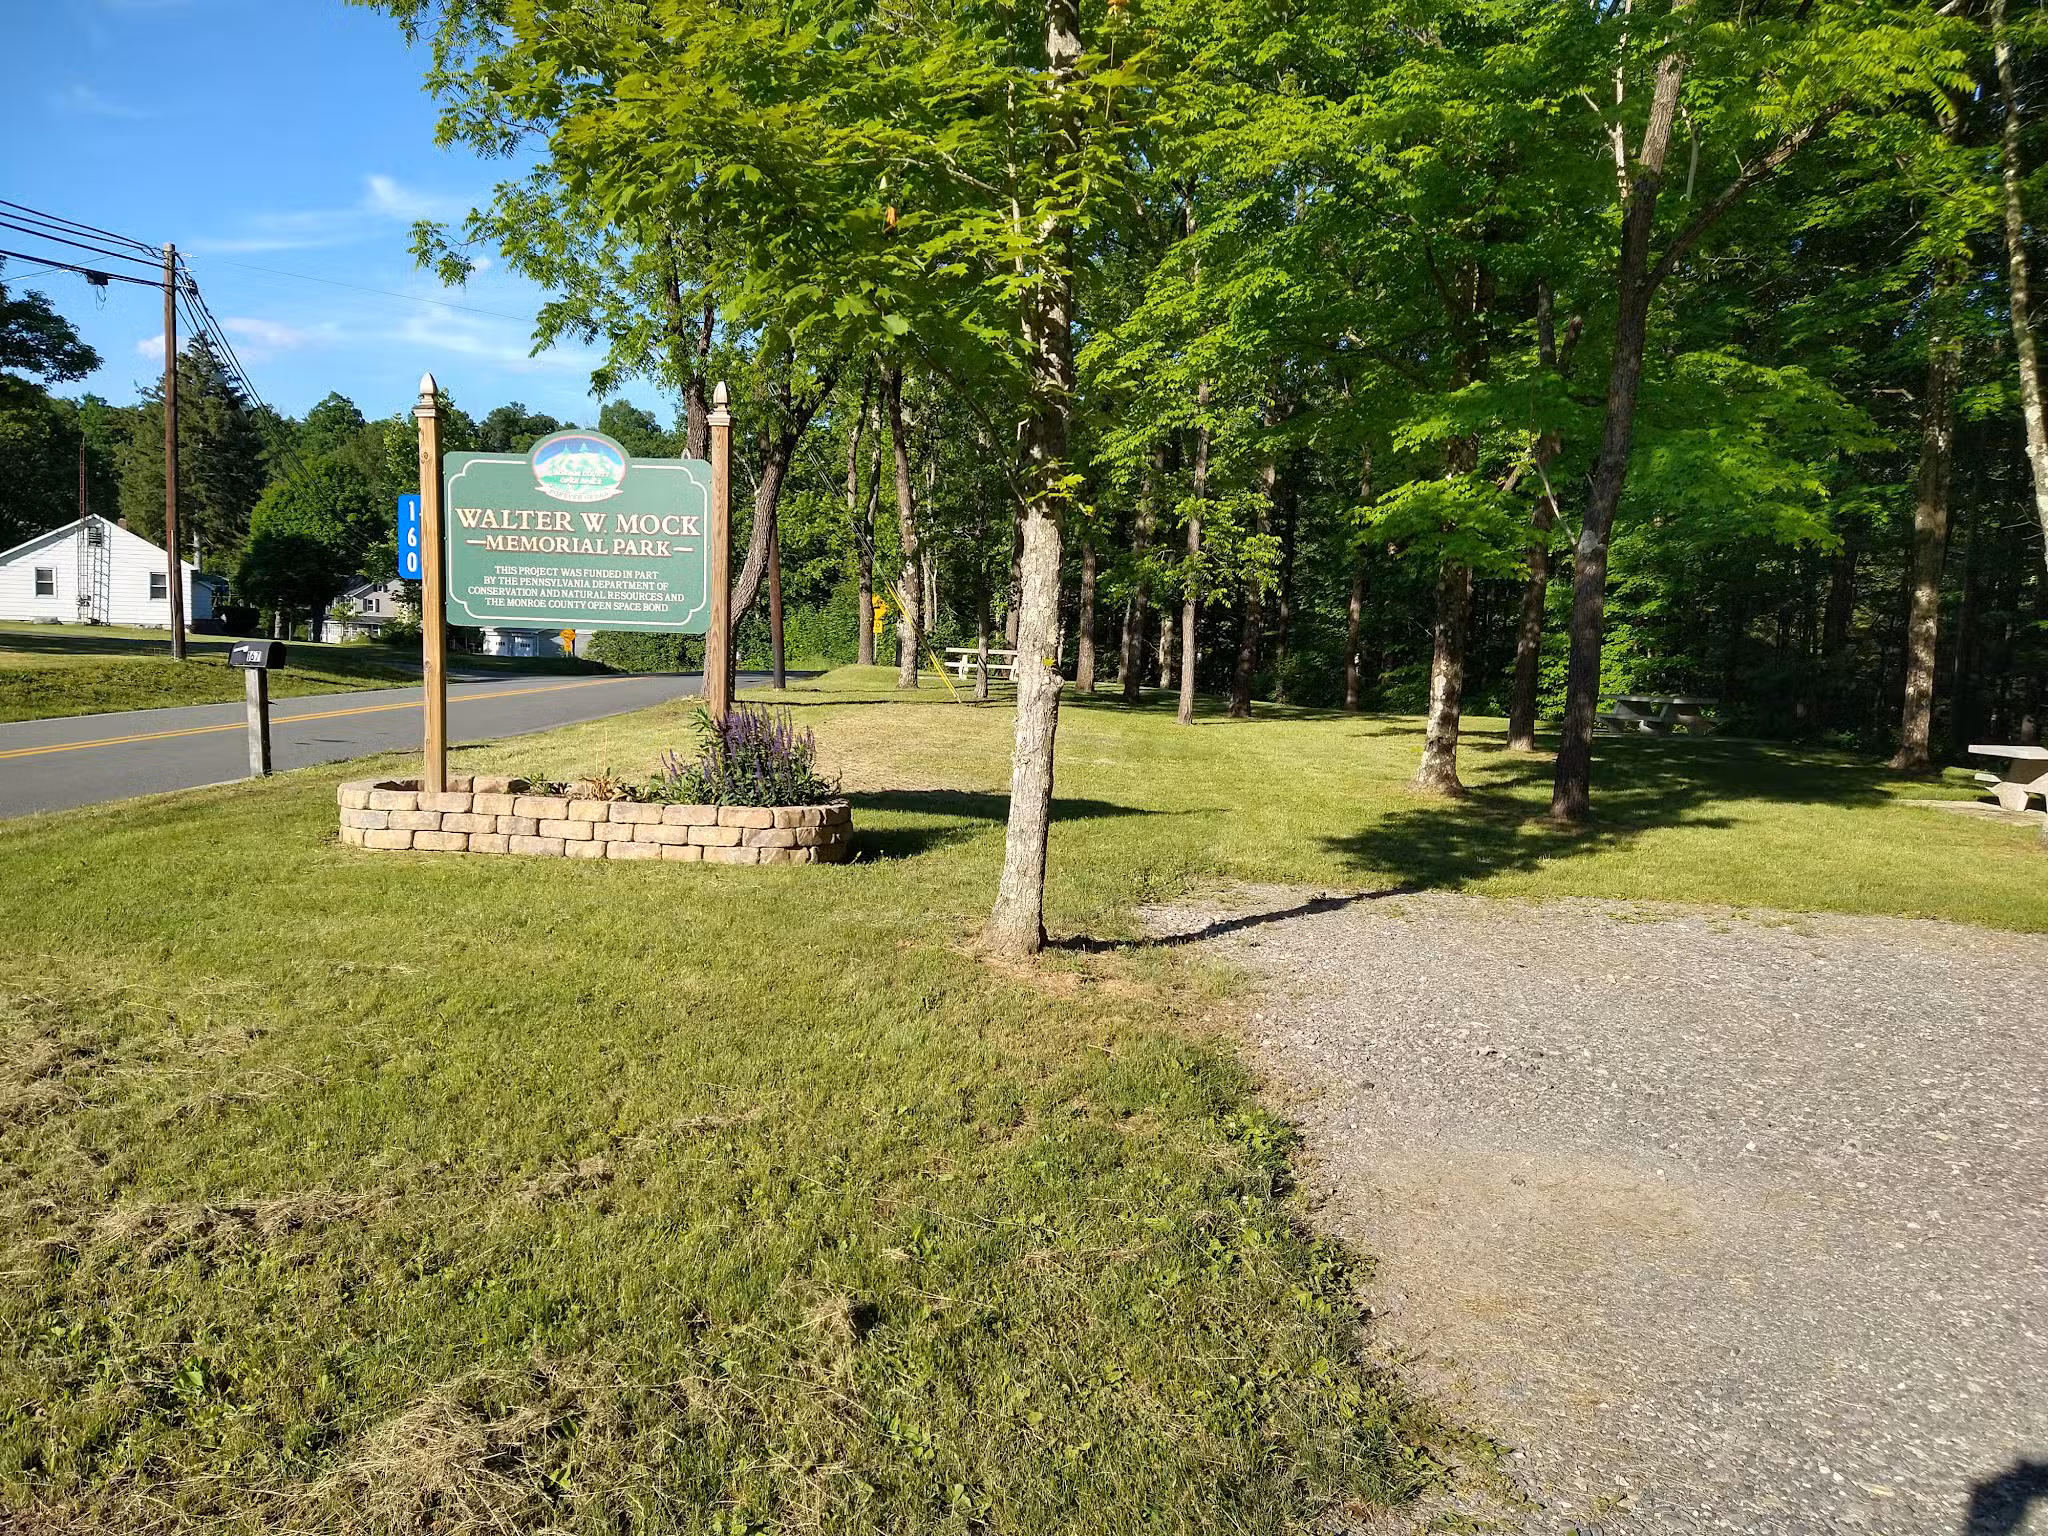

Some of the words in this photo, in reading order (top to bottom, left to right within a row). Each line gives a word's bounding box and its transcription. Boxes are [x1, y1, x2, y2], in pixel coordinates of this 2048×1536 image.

[455, 508, 576, 532] WALTER
[580, 512, 608, 534] W.
[615, 513, 701, 536] MOCK
[407, 500, 417, 573] 160
[485, 534, 609, 555] MEMORIAL
[612, 539, 672, 557] PARK
[494, 566, 518, 575] THIS
[518, 566, 559, 577] PROJECT
[560, 568, 582, 577] WAS
[584, 569, 622, 579] FUNDED
[623, 570, 633, 579] IN
[634, 570, 660, 580] PART
[484, 576, 497, 585] BY
[498, 576, 517, 586] THE
[520, 577, 590, 588] PENNSYLVANIA
[592, 580, 656, 590] DEPARTMENT
[657, 582, 669, 591] OF
[468, 586, 538, 597] CONSERVATION
[540, 589, 560, 598] AND
[562, 590, 606, 600] NATURAL
[607, 591, 663, 602] RESOURCES
[664, 593, 685, 602] AND
[485, 598, 506, 607] THE
[506, 598, 546, 608] MONROE
[548, 600, 586, 610] COUNTY
[588, 601, 612, 611] OPEN
[613, 602, 641, 612] SPACE
[641, 603, 669, 612] BOND
